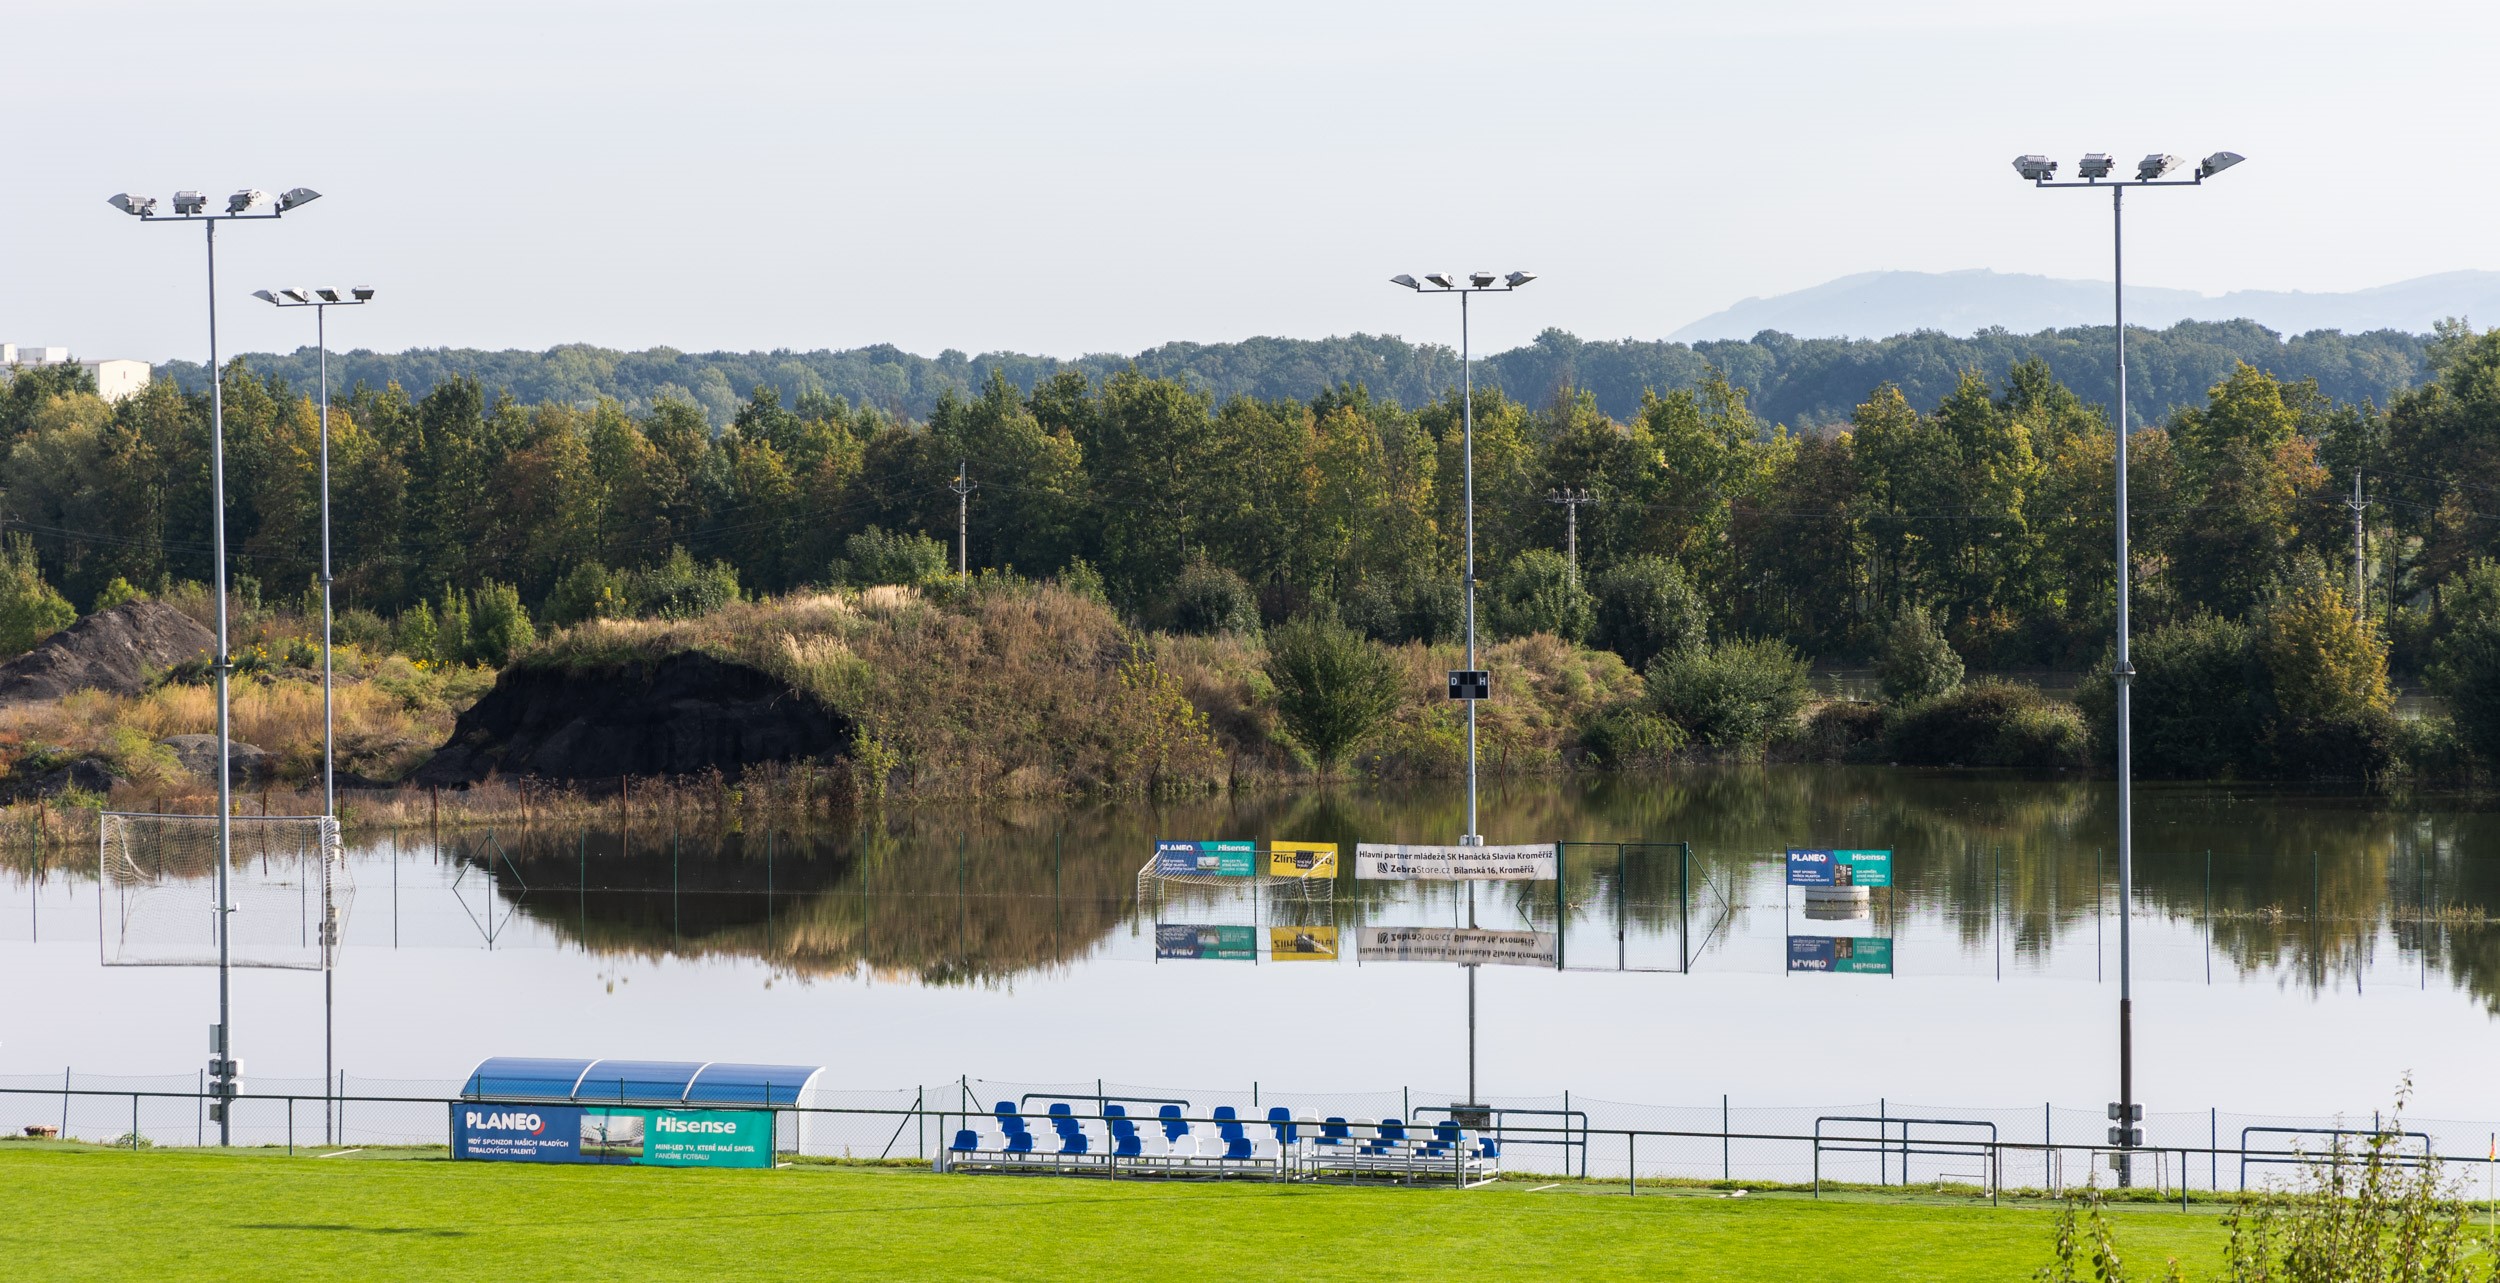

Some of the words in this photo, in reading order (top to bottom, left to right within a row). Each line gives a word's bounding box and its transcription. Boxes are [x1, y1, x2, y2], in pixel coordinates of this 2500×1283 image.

[1451, 677, 1458, 686] D
[1479, 677, 1486, 686] H
[1217, 844, 1251, 852] Hisense
[1359, 850, 1383, 859] Hlavní
[1384, 851, 1412, 860] partner
[1413, 852, 1446, 860] mládeže
[1458, 852, 1491, 860] Hanácká
[1492, 852, 1515, 860] Slavia
[1517, 850, 1553, 860] Kroměříž
[1791, 853, 1827, 862] PLANEO
[1851, 853, 1887, 861] Hisense
[1390, 864, 1451, 874] ZebraStore.cz
[1487, 866, 1498, 875] 16,
[1499, 865, 1535, 874] Kroměříž
[466, 1111, 542, 1132] PLANEO
[655, 1116, 737, 1134] Hisense
[482, 1138, 513, 1146] SPONZOR
[514, 1137, 538, 1147] NAŠICH
[538, 1139, 569, 1148] MLADÝCH
[510, 1146, 537, 1155] TALENTŮ
[655, 1143, 684, 1151] MINI-LED
[685, 1144, 696, 1152] TV,
[697, 1143, 717, 1152] KTERÉ
[717, 1143, 733, 1152] MAJÍ
[734, 1145, 755, 1153] SMYSL
[655, 1151, 682, 1160] FANDÍME
